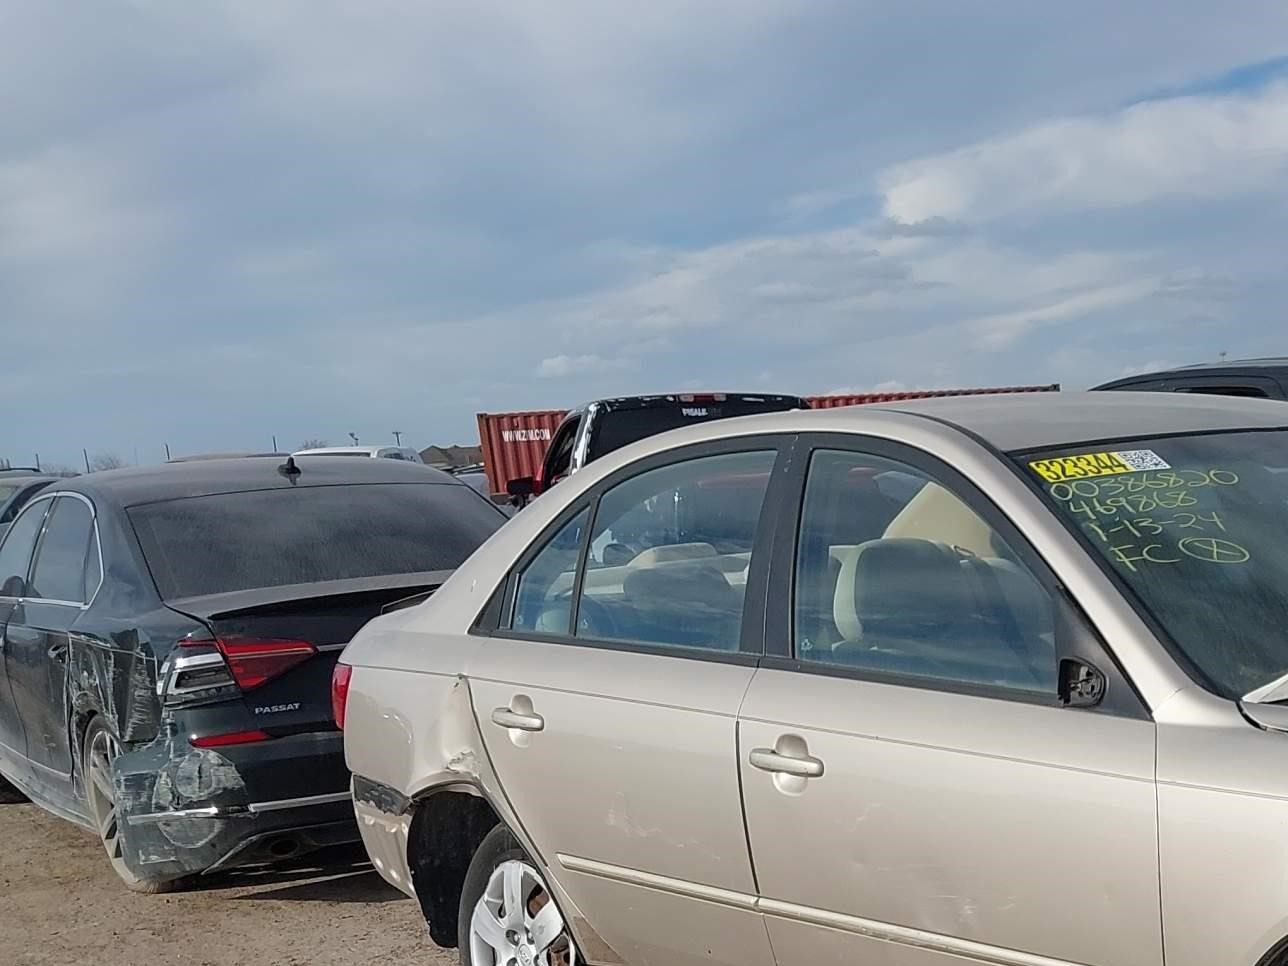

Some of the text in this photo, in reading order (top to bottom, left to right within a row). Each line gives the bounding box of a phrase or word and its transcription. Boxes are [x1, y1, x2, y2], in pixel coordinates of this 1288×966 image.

[1035, 453, 1131, 480] 323344
[1051, 470, 1239, 500] 00386820
[1088, 512, 1226, 541] 1-13-24
[255, 703, 300, 714] PASSAT
